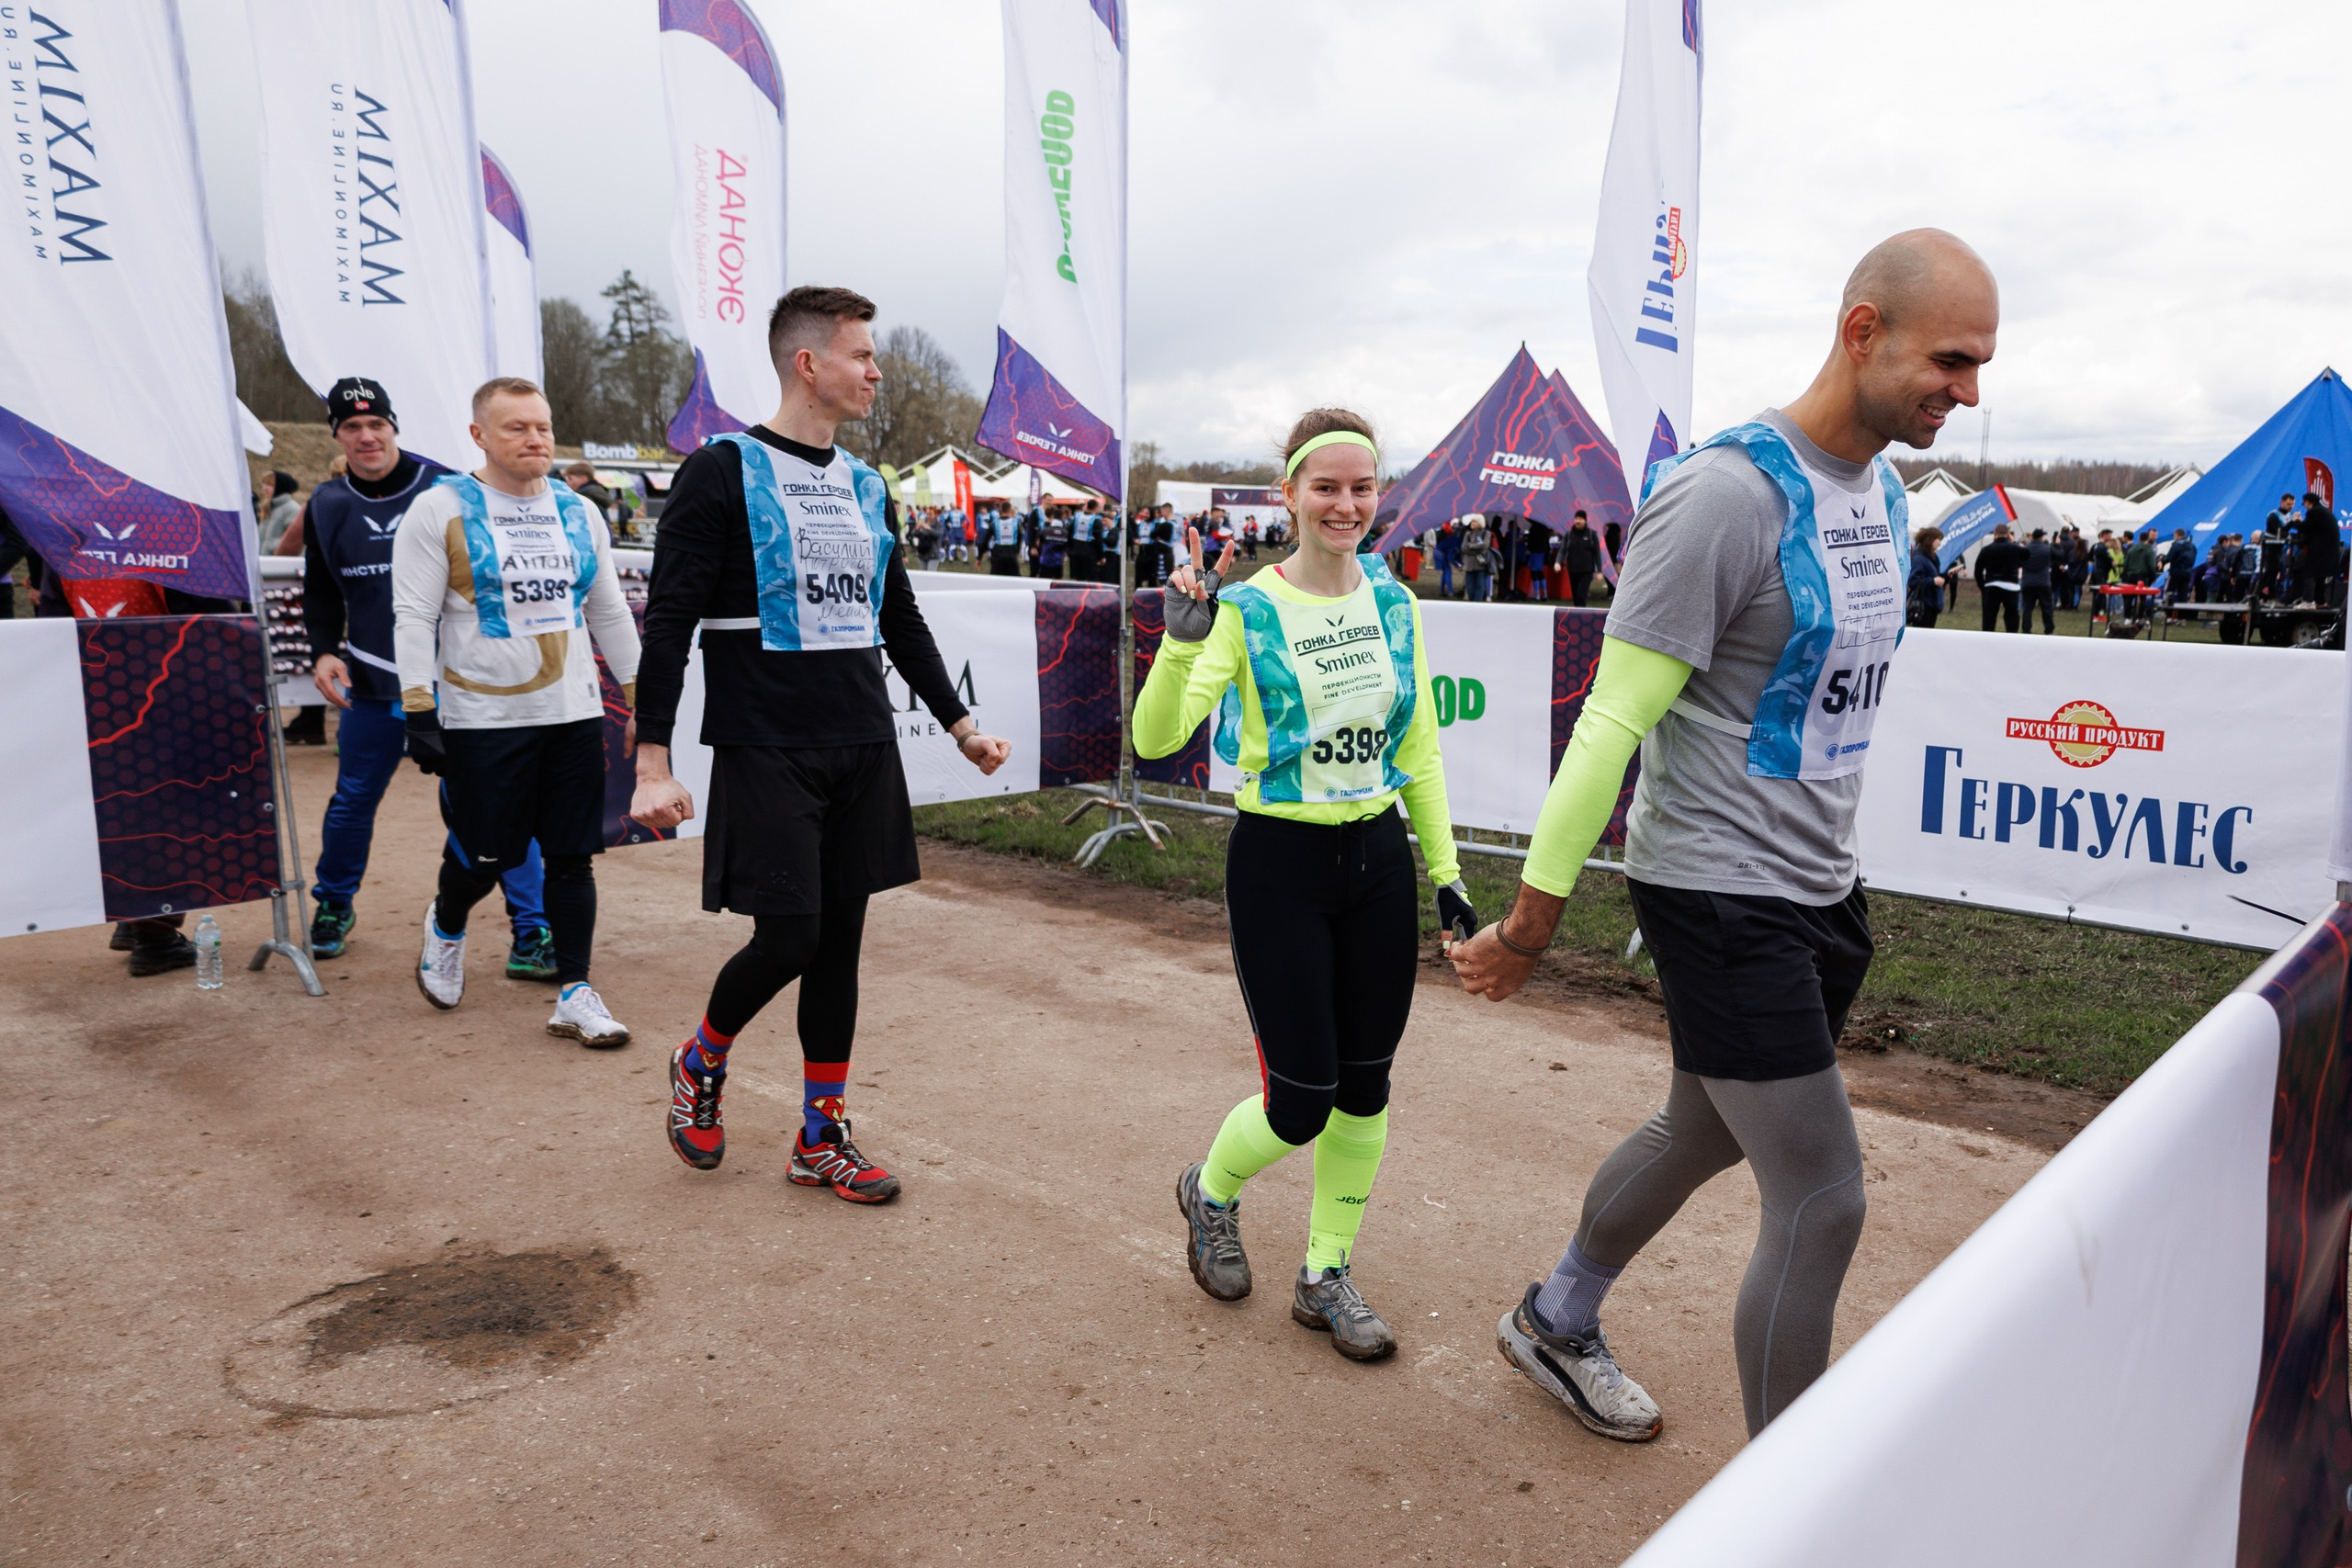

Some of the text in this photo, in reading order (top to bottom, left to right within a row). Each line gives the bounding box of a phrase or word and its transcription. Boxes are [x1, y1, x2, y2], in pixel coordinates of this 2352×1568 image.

[343, 384, 375, 401] DNB
[1491, 451, 1555, 472] ГОНКА
[1479, 468, 1555, 491] ГЕРОЕВ
[783, 484, 853, 497] ГОНКА ГЕРОЕВ
[799, 502, 852, 516] Sminex
[526, 514, 557, 523] ГЕРОЕВ
[506, 527, 552, 539] Sminex
[1824, 525, 1889, 544] ГОНКА ГЕРОЕВ
[341, 563, 392, 576] ИНСТР
[1840, 555, 1889, 580] Sminex
[806, 573, 868, 604] 5409
[1849, 598, 1894, 611] FINE DEVELOPMENT
[1295, 626, 1380, 652] ГОНКА ГЕРОЕВ
[1315, 651, 1377, 675] Sminex
[1321, 673, 1382, 691] ПЕРФЕКЦИОНИСТЫ
[1324, 682, 1383, 700] FINE DEVELOPMENT
[2009, 721, 2161, 749] РУССКИЙ ПРОДУКТ
[1921, 745, 2253, 874] ГЕРКУЛЕС
[1737, 862, 1766, 871] DRI-FIT
